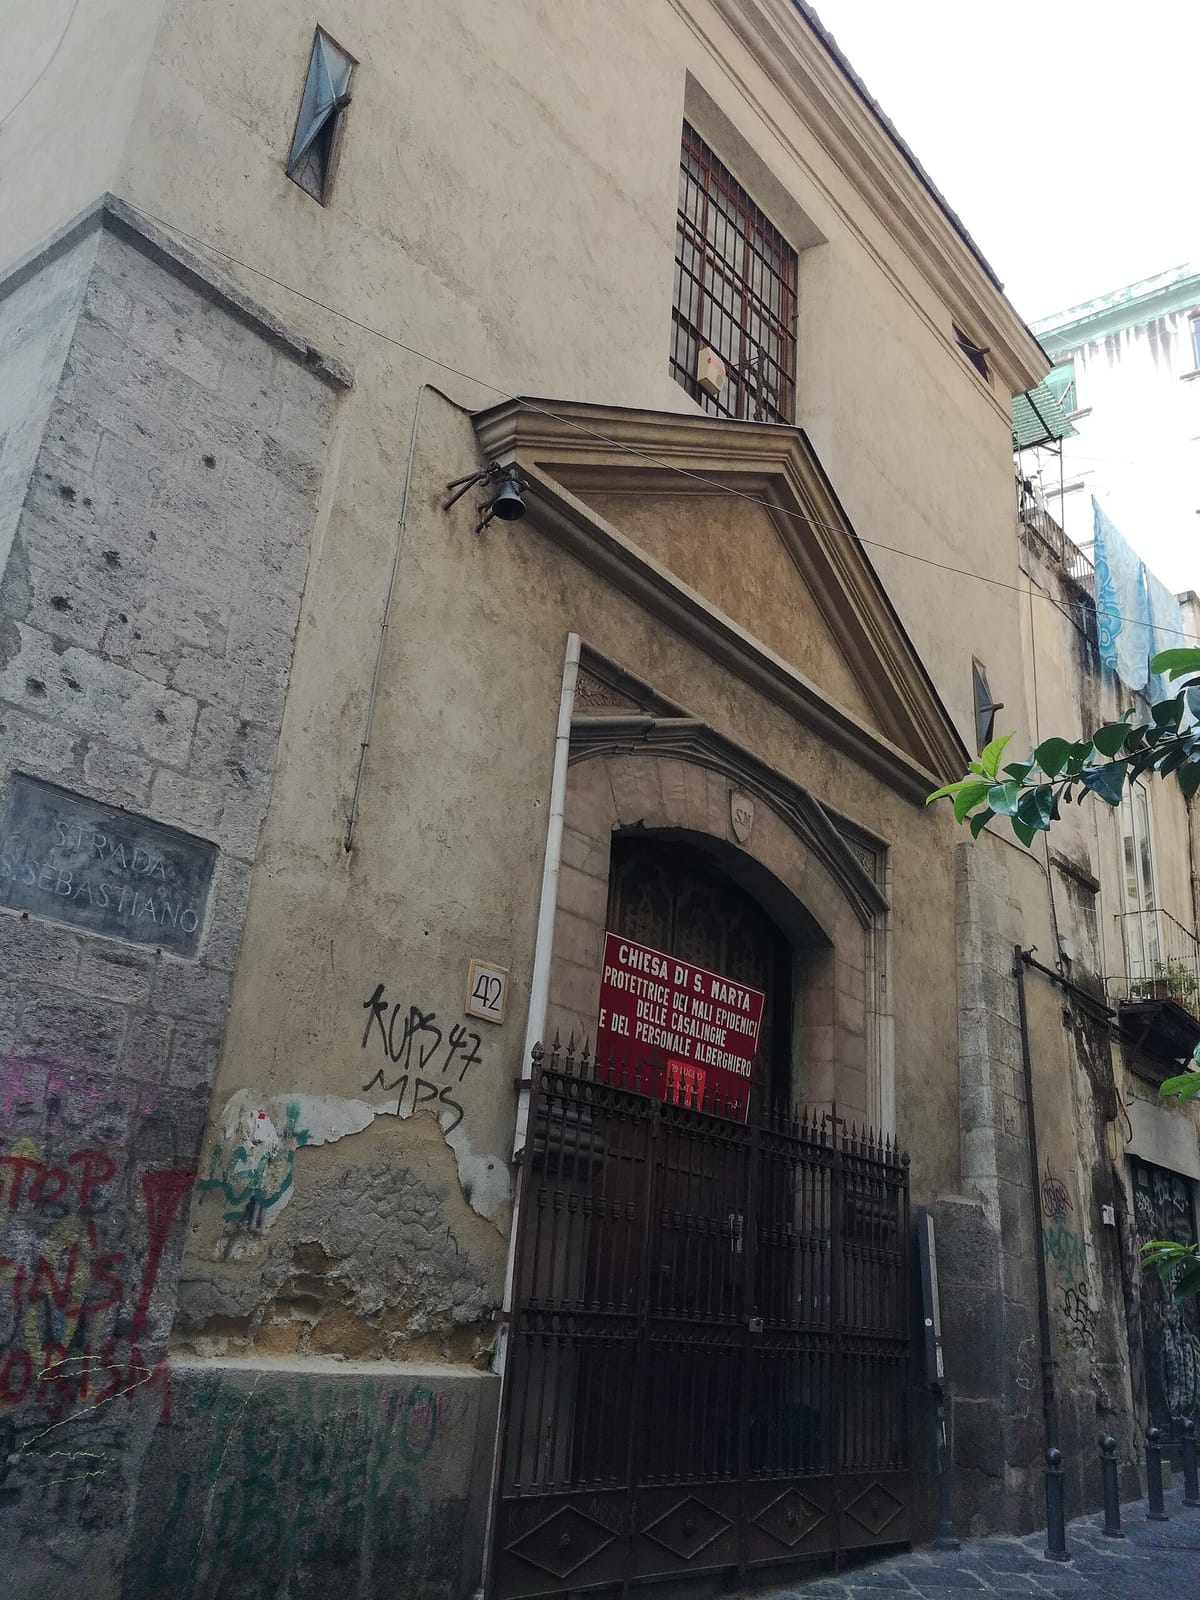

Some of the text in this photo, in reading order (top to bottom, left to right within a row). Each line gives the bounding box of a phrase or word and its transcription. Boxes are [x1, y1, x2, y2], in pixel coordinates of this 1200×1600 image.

[55, 821, 167, 880] STRADA
[22, 858, 199, 932] SEBASTIANO
[472, 974, 502, 1011] 42
[604, 965, 758, 1038] PROTETTRICE DEI MALI EPIDEMICI
[618, 944, 750, 1011] CHIESA DI S. MARTA
[599, 1007, 752, 1077] E DEL PERSONALE ALBERGHIERO
[636, 999, 727, 1047] DELLE CASALINGHE
[0, 1138, 117, 1208] TOP
